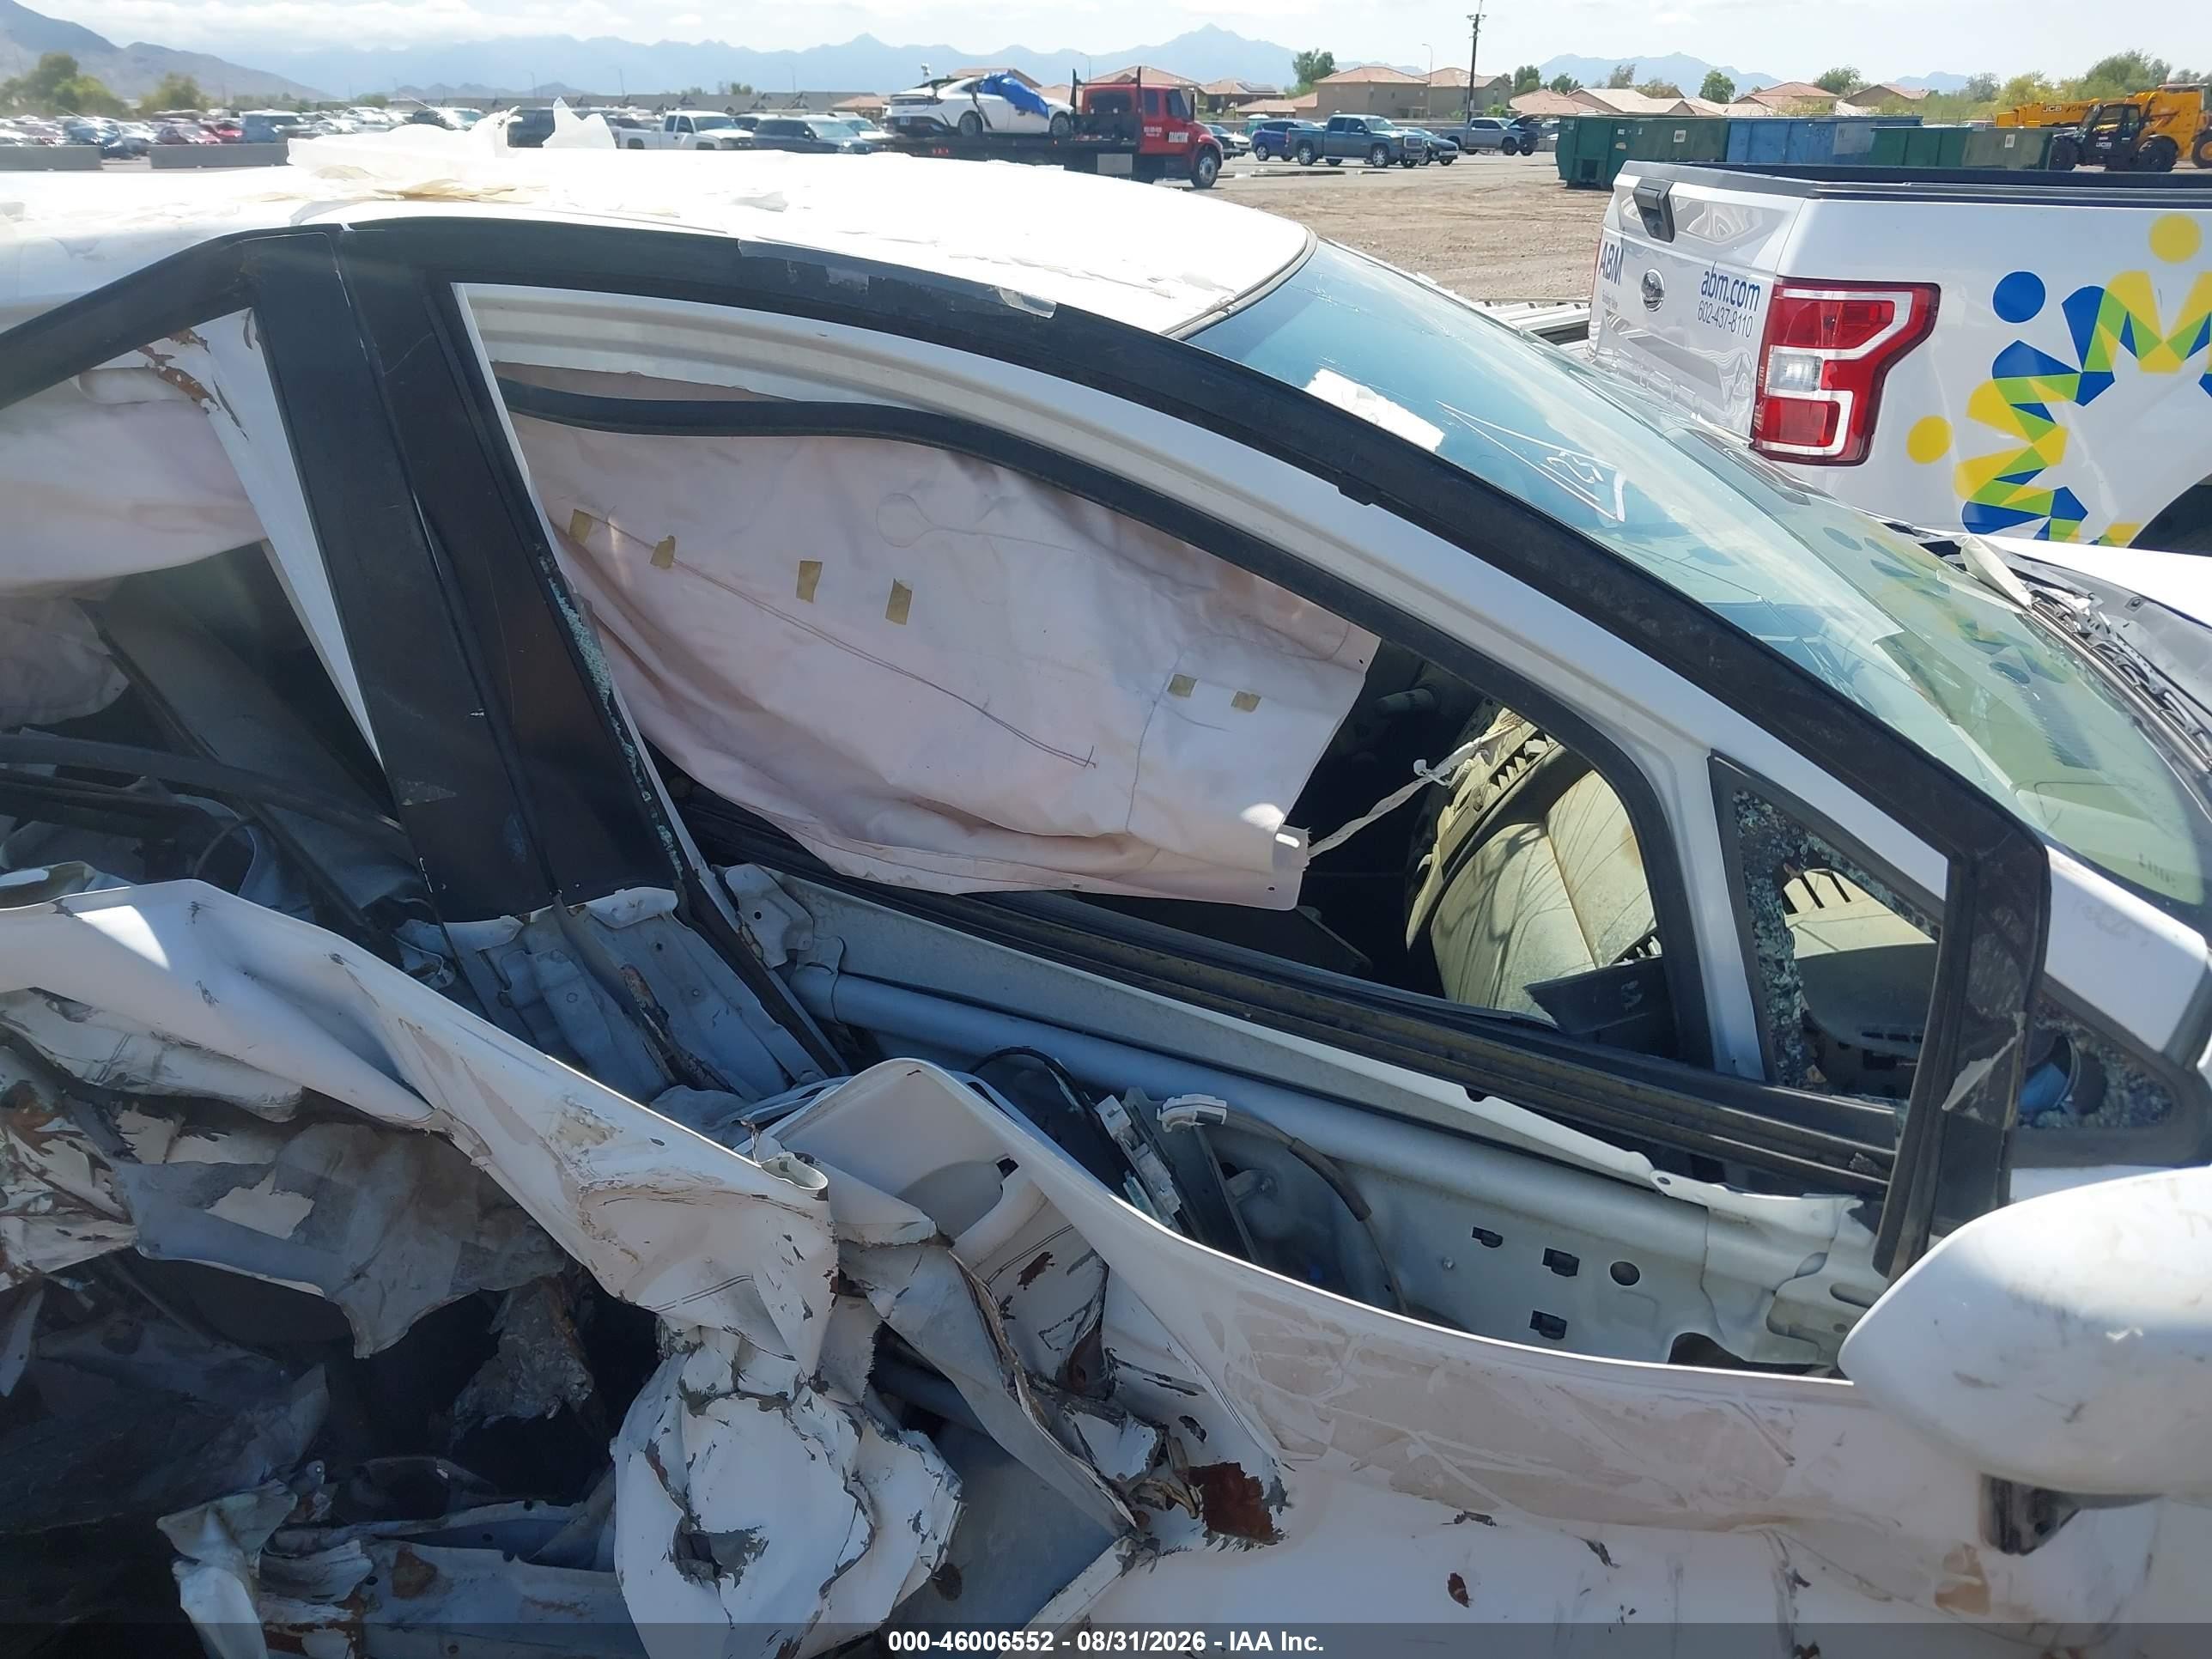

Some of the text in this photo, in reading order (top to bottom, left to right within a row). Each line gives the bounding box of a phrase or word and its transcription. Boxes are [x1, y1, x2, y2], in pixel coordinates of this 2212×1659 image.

[1598, 241, 1624, 285] ABM
[1700, 261, 1760, 312] abm.com
[1698, 300, 1753, 337] 602-437-8110
